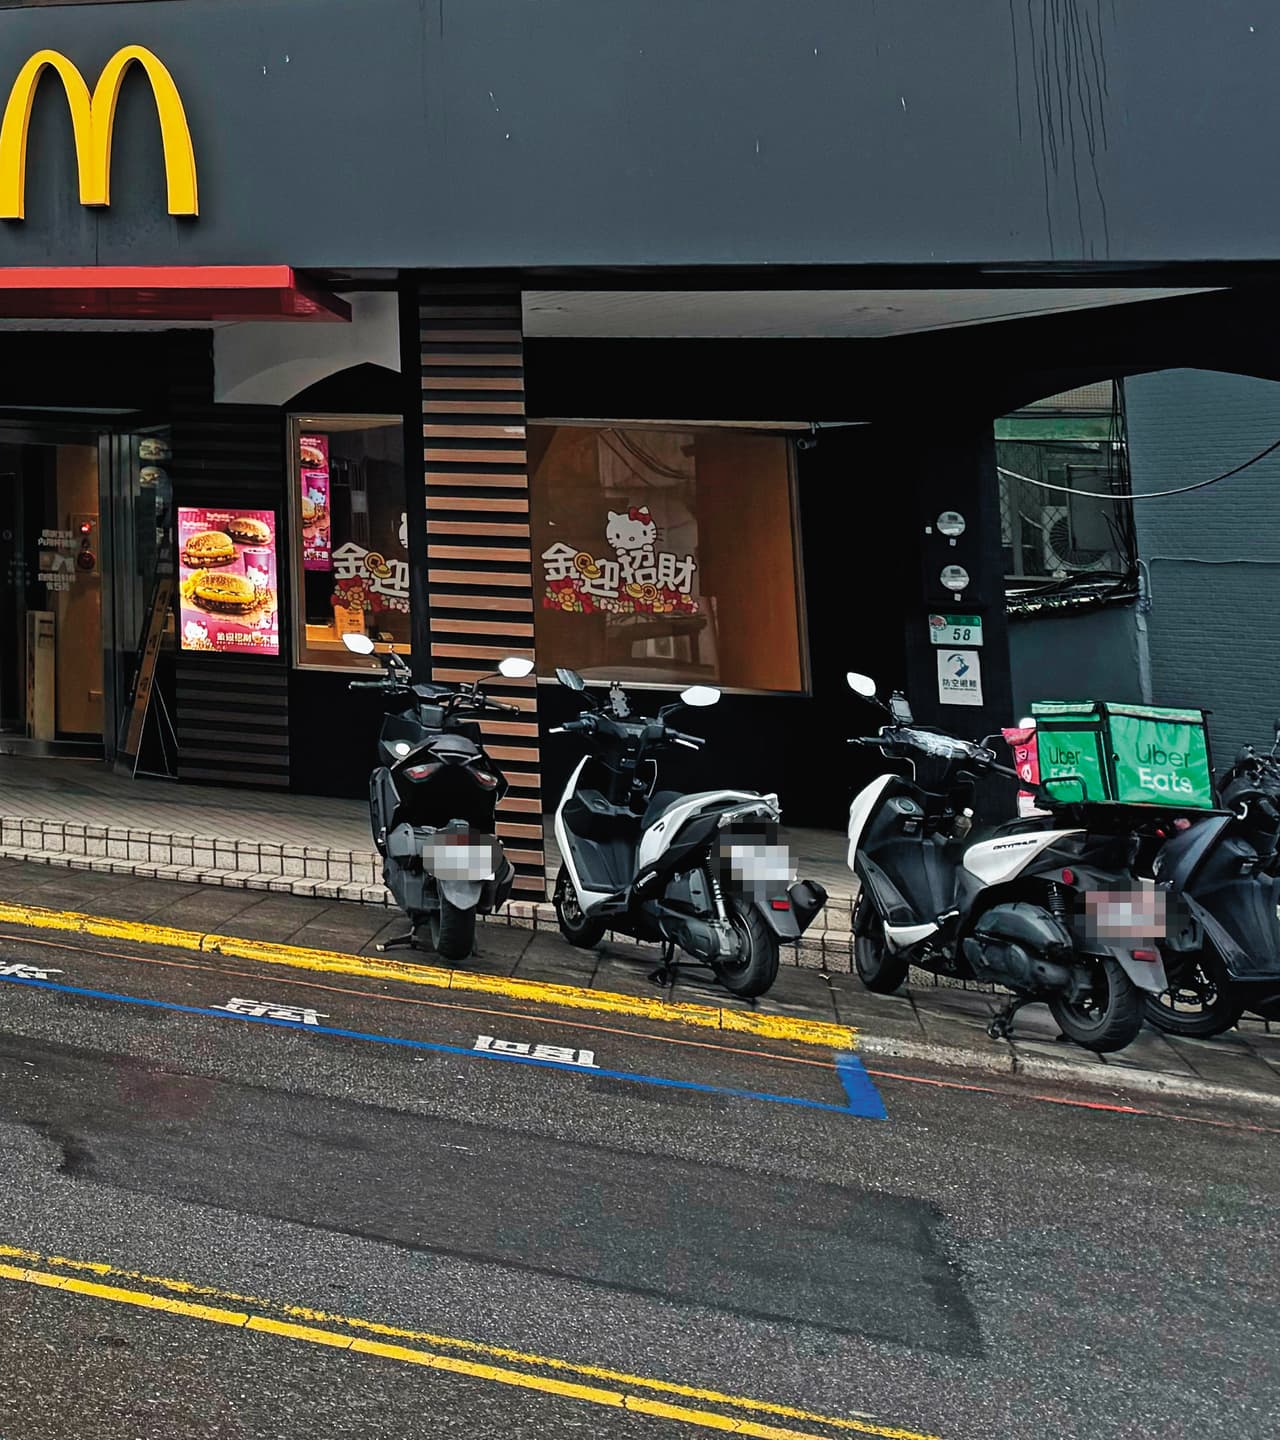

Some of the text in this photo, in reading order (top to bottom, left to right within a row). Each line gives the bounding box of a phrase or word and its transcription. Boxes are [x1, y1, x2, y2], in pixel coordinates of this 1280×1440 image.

[541, 542, 697, 598] 金迎招財
[953, 628, 971, 641] 58
[1048, 746, 1082, 766] Uber
[1135, 742, 1191, 768] Uber
[1139, 767, 1194, 794] Eats
